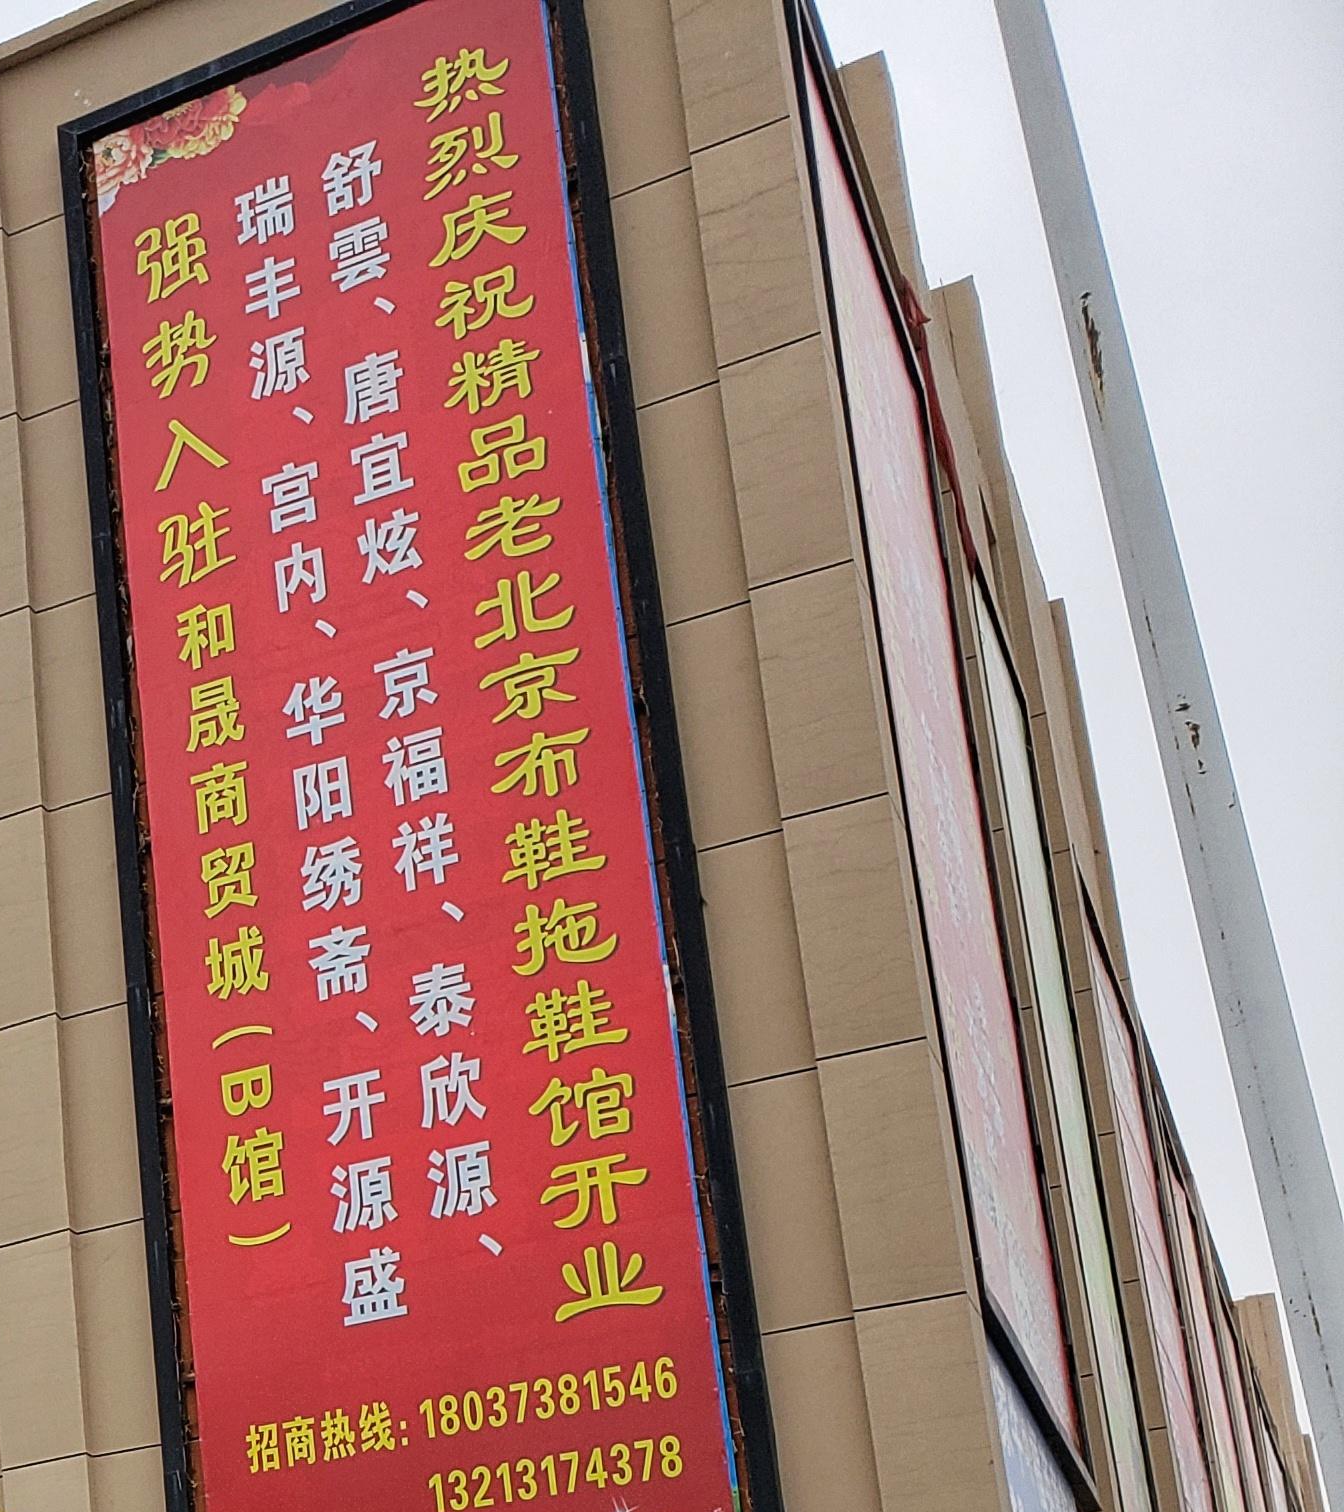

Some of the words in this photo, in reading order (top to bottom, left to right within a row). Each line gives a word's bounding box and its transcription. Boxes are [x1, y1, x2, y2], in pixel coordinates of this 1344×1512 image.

[412, 46, 664, 1323] 热烈庆祝精品老北京布鞋拖鞋馆开业
[418, 1355, 680, 1441] 18037381546
